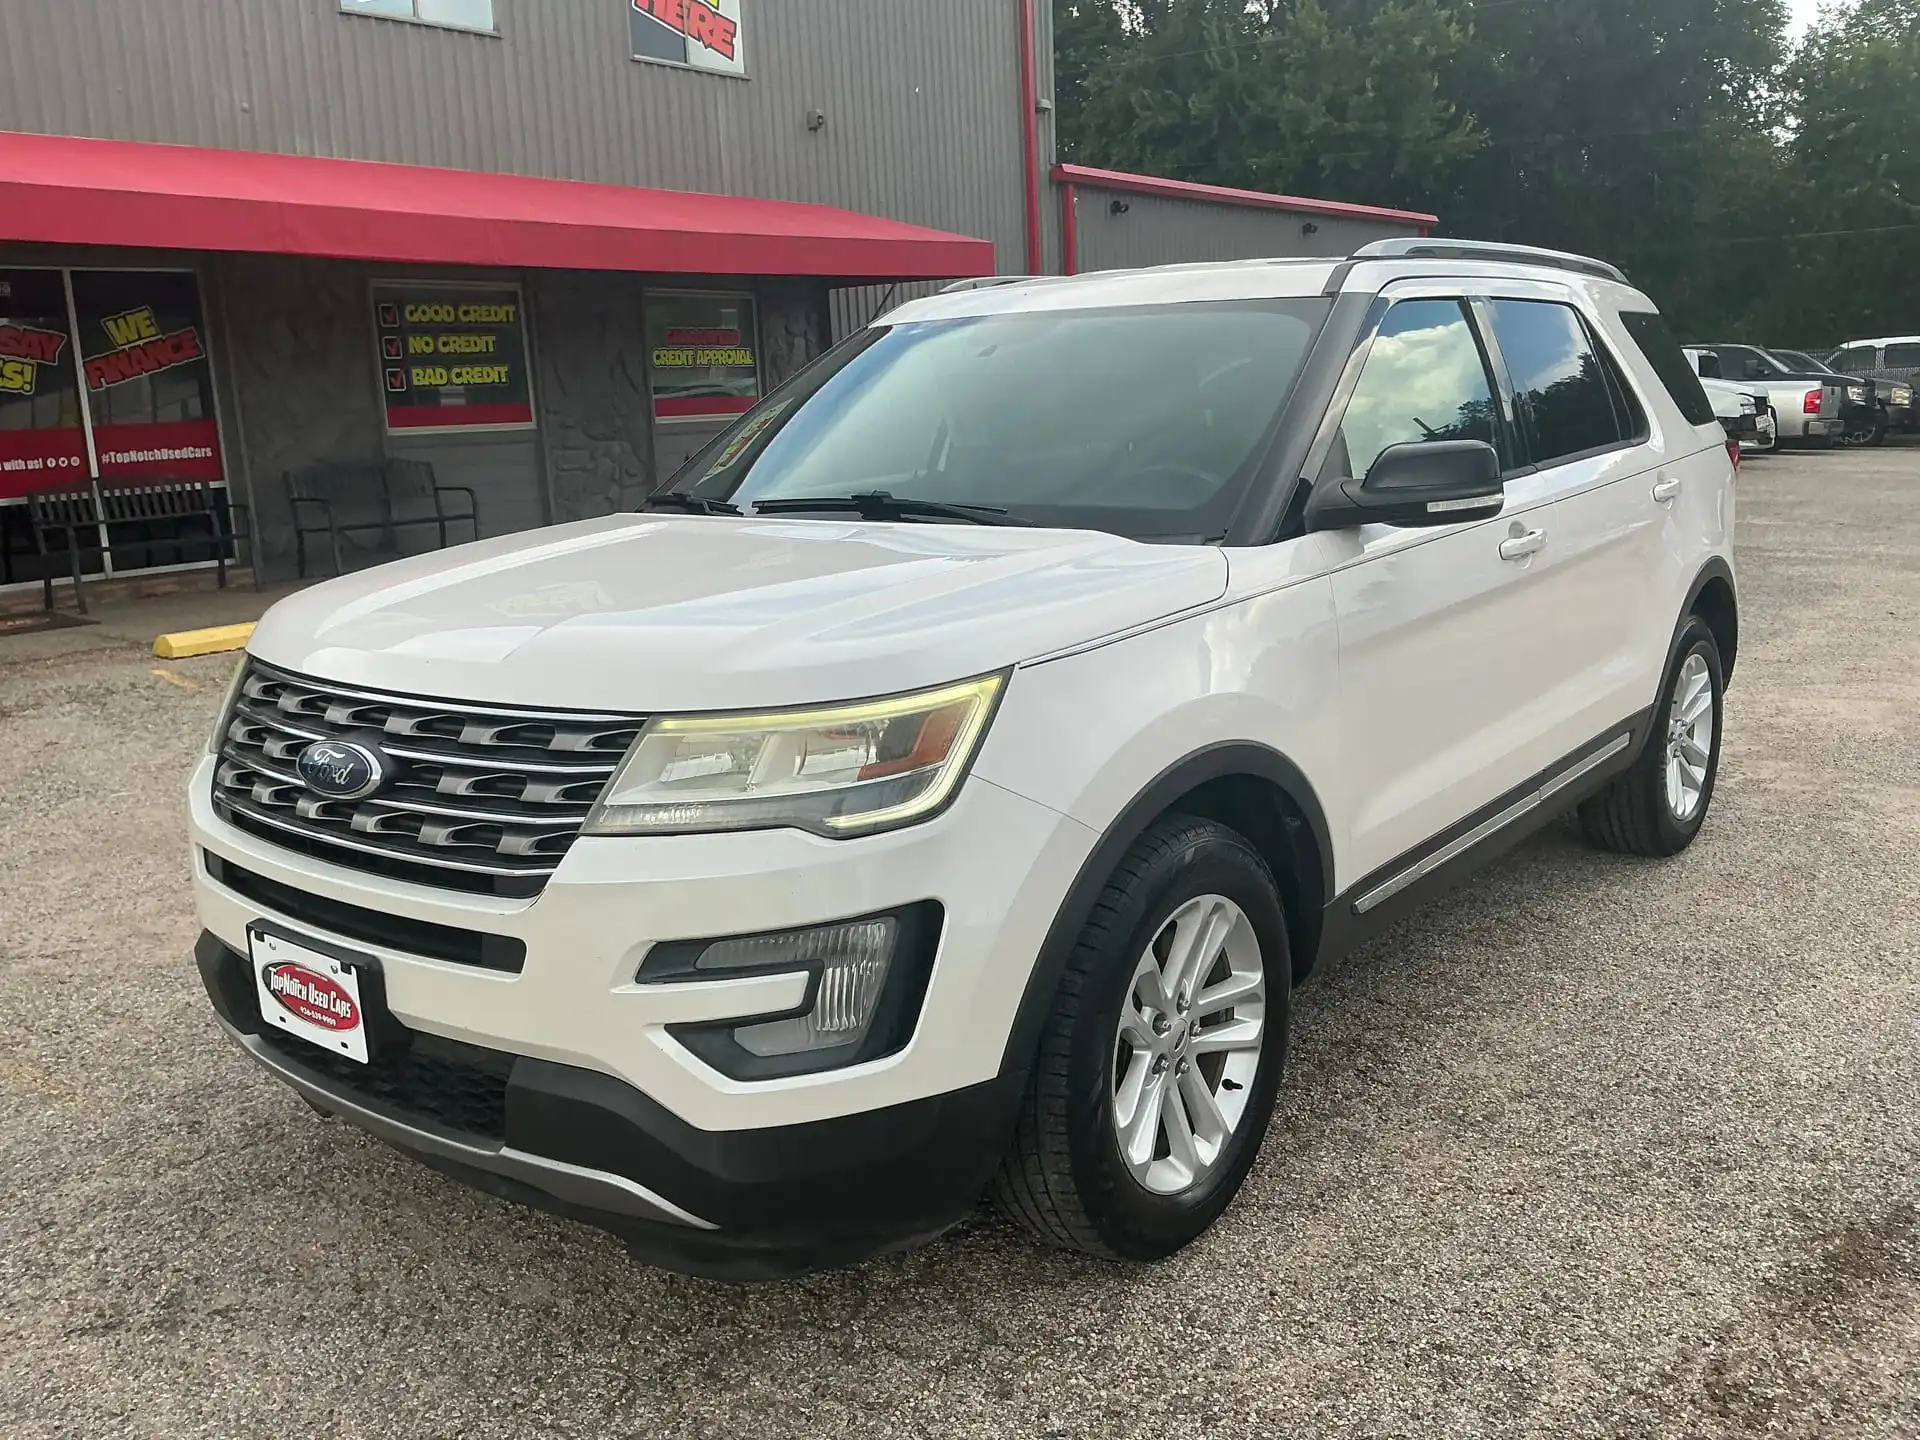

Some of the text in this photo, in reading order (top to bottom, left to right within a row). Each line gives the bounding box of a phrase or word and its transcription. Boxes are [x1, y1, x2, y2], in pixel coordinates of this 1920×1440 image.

[404, 305, 517, 322] GOOD CREDIT
[104, 309, 158, 346] WE
[0, 325, 64, 363] SAY
[408, 335, 497, 353] NO CREDIT
[84, 328, 202, 389] FINANCE
[653, 349, 753, 366] CREDIT APPROVAL
[411, 366, 509, 386] BAD CREDIT
[101, 447, 213, 464] #TopNotchUsedCars
[308, 748, 355, 785] Ford
